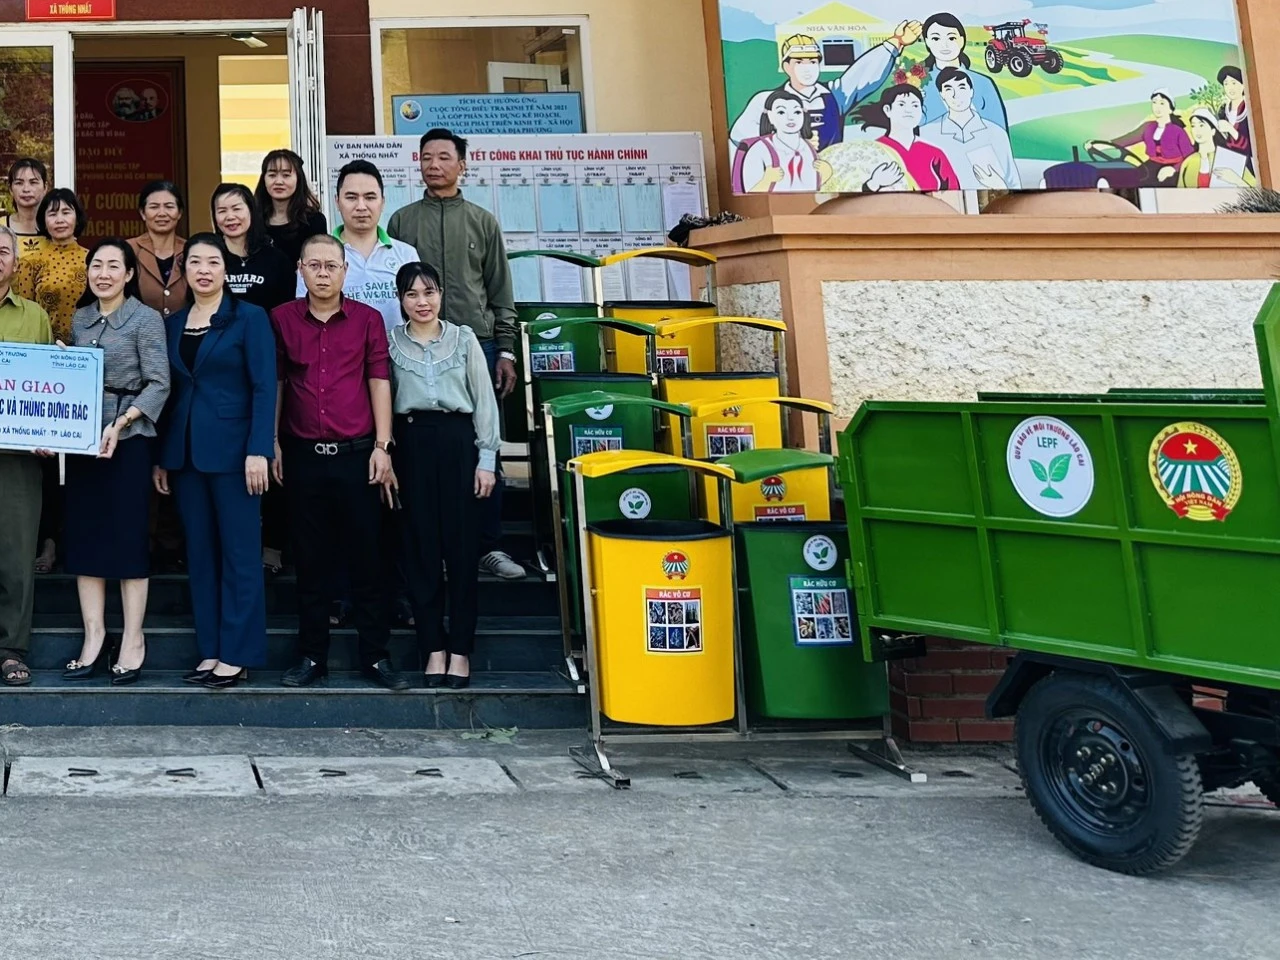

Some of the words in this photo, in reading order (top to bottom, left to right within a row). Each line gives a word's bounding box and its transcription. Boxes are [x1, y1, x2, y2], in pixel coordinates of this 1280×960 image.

[470, 148, 486, 161] YẾT
[490, 148, 517, 161] CÔNG
[520, 150, 541, 160] KHAI
[545, 146, 563, 160] THỦ
[566, 152, 584, 161] TỤC
[587, 148, 614, 160] HÀNH
[618, 147, 648, 160] CHÍNH
[225, 274, 264, 284] ARVARD
[366, 282, 389, 290] SAVE
[21, 380, 65, 394] GIAO
[7, 399, 16, 415] VÀ
[20, 397, 45, 418] THÙNG
[48, 401, 69, 422] ĐỰNG
[72, 400, 88, 420] RÁC
[1037, 437, 1058, 449] LEPF
